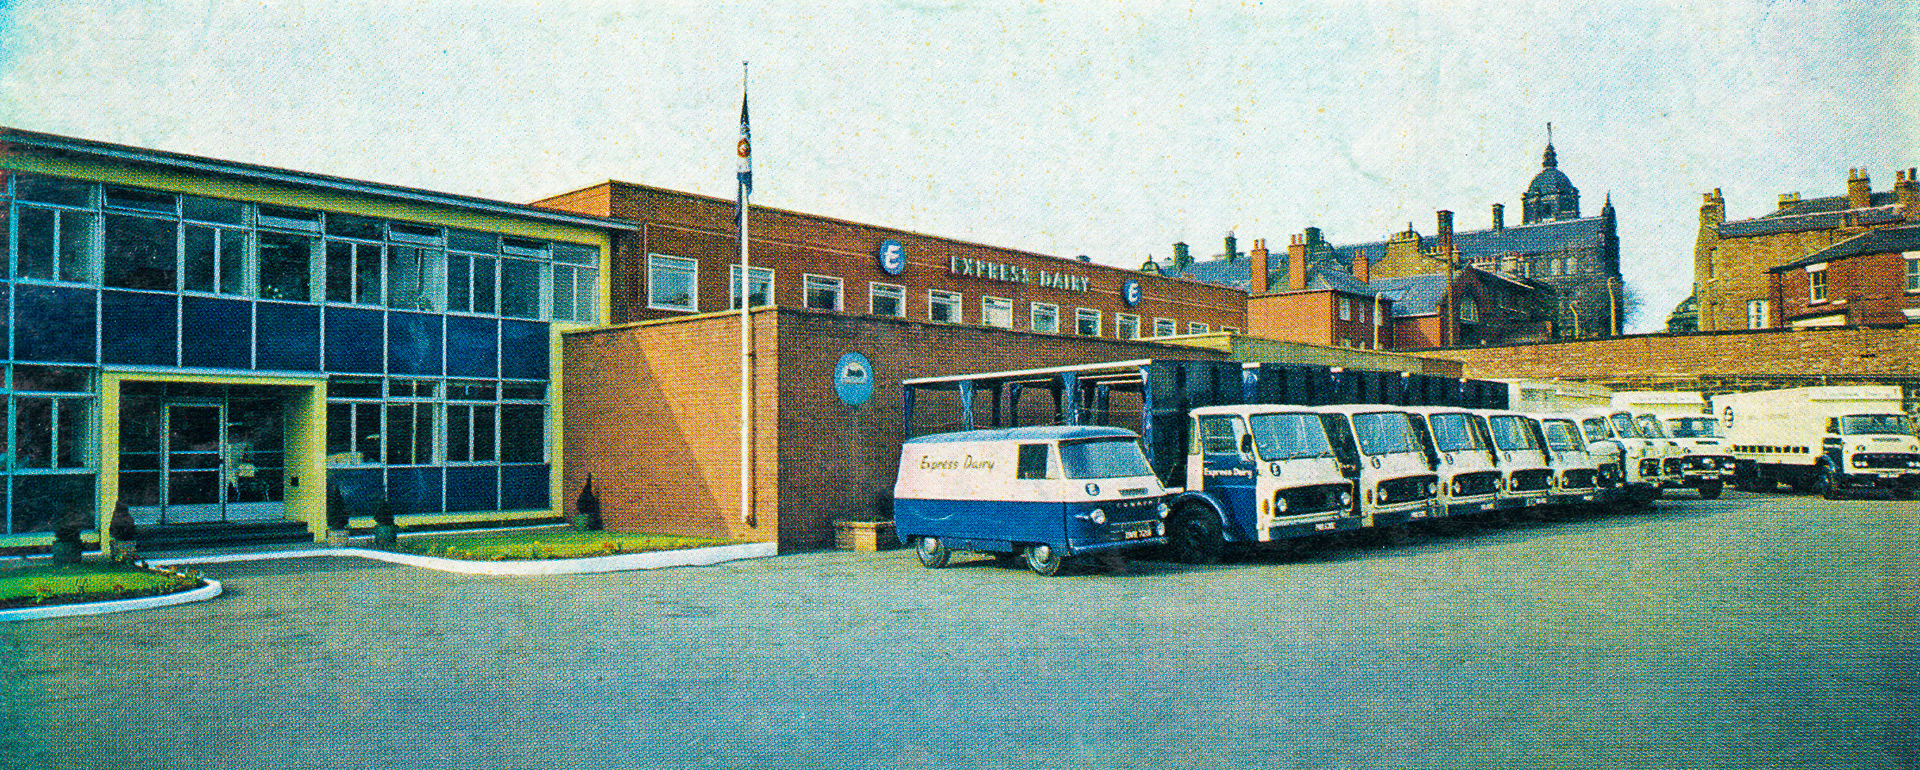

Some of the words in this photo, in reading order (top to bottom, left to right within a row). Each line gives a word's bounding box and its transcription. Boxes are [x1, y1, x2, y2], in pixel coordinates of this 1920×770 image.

[884, 244, 901, 269] E
[950, 255, 1030, 283] EXPRESS
[1039, 269, 1089, 292] DAIRY
[920, 455, 959, 473] Express
[963, 454, 995, 473] Dairy
[1203, 467, 1233, 479] Express
[1232, 467, 1253, 480] Dairy
